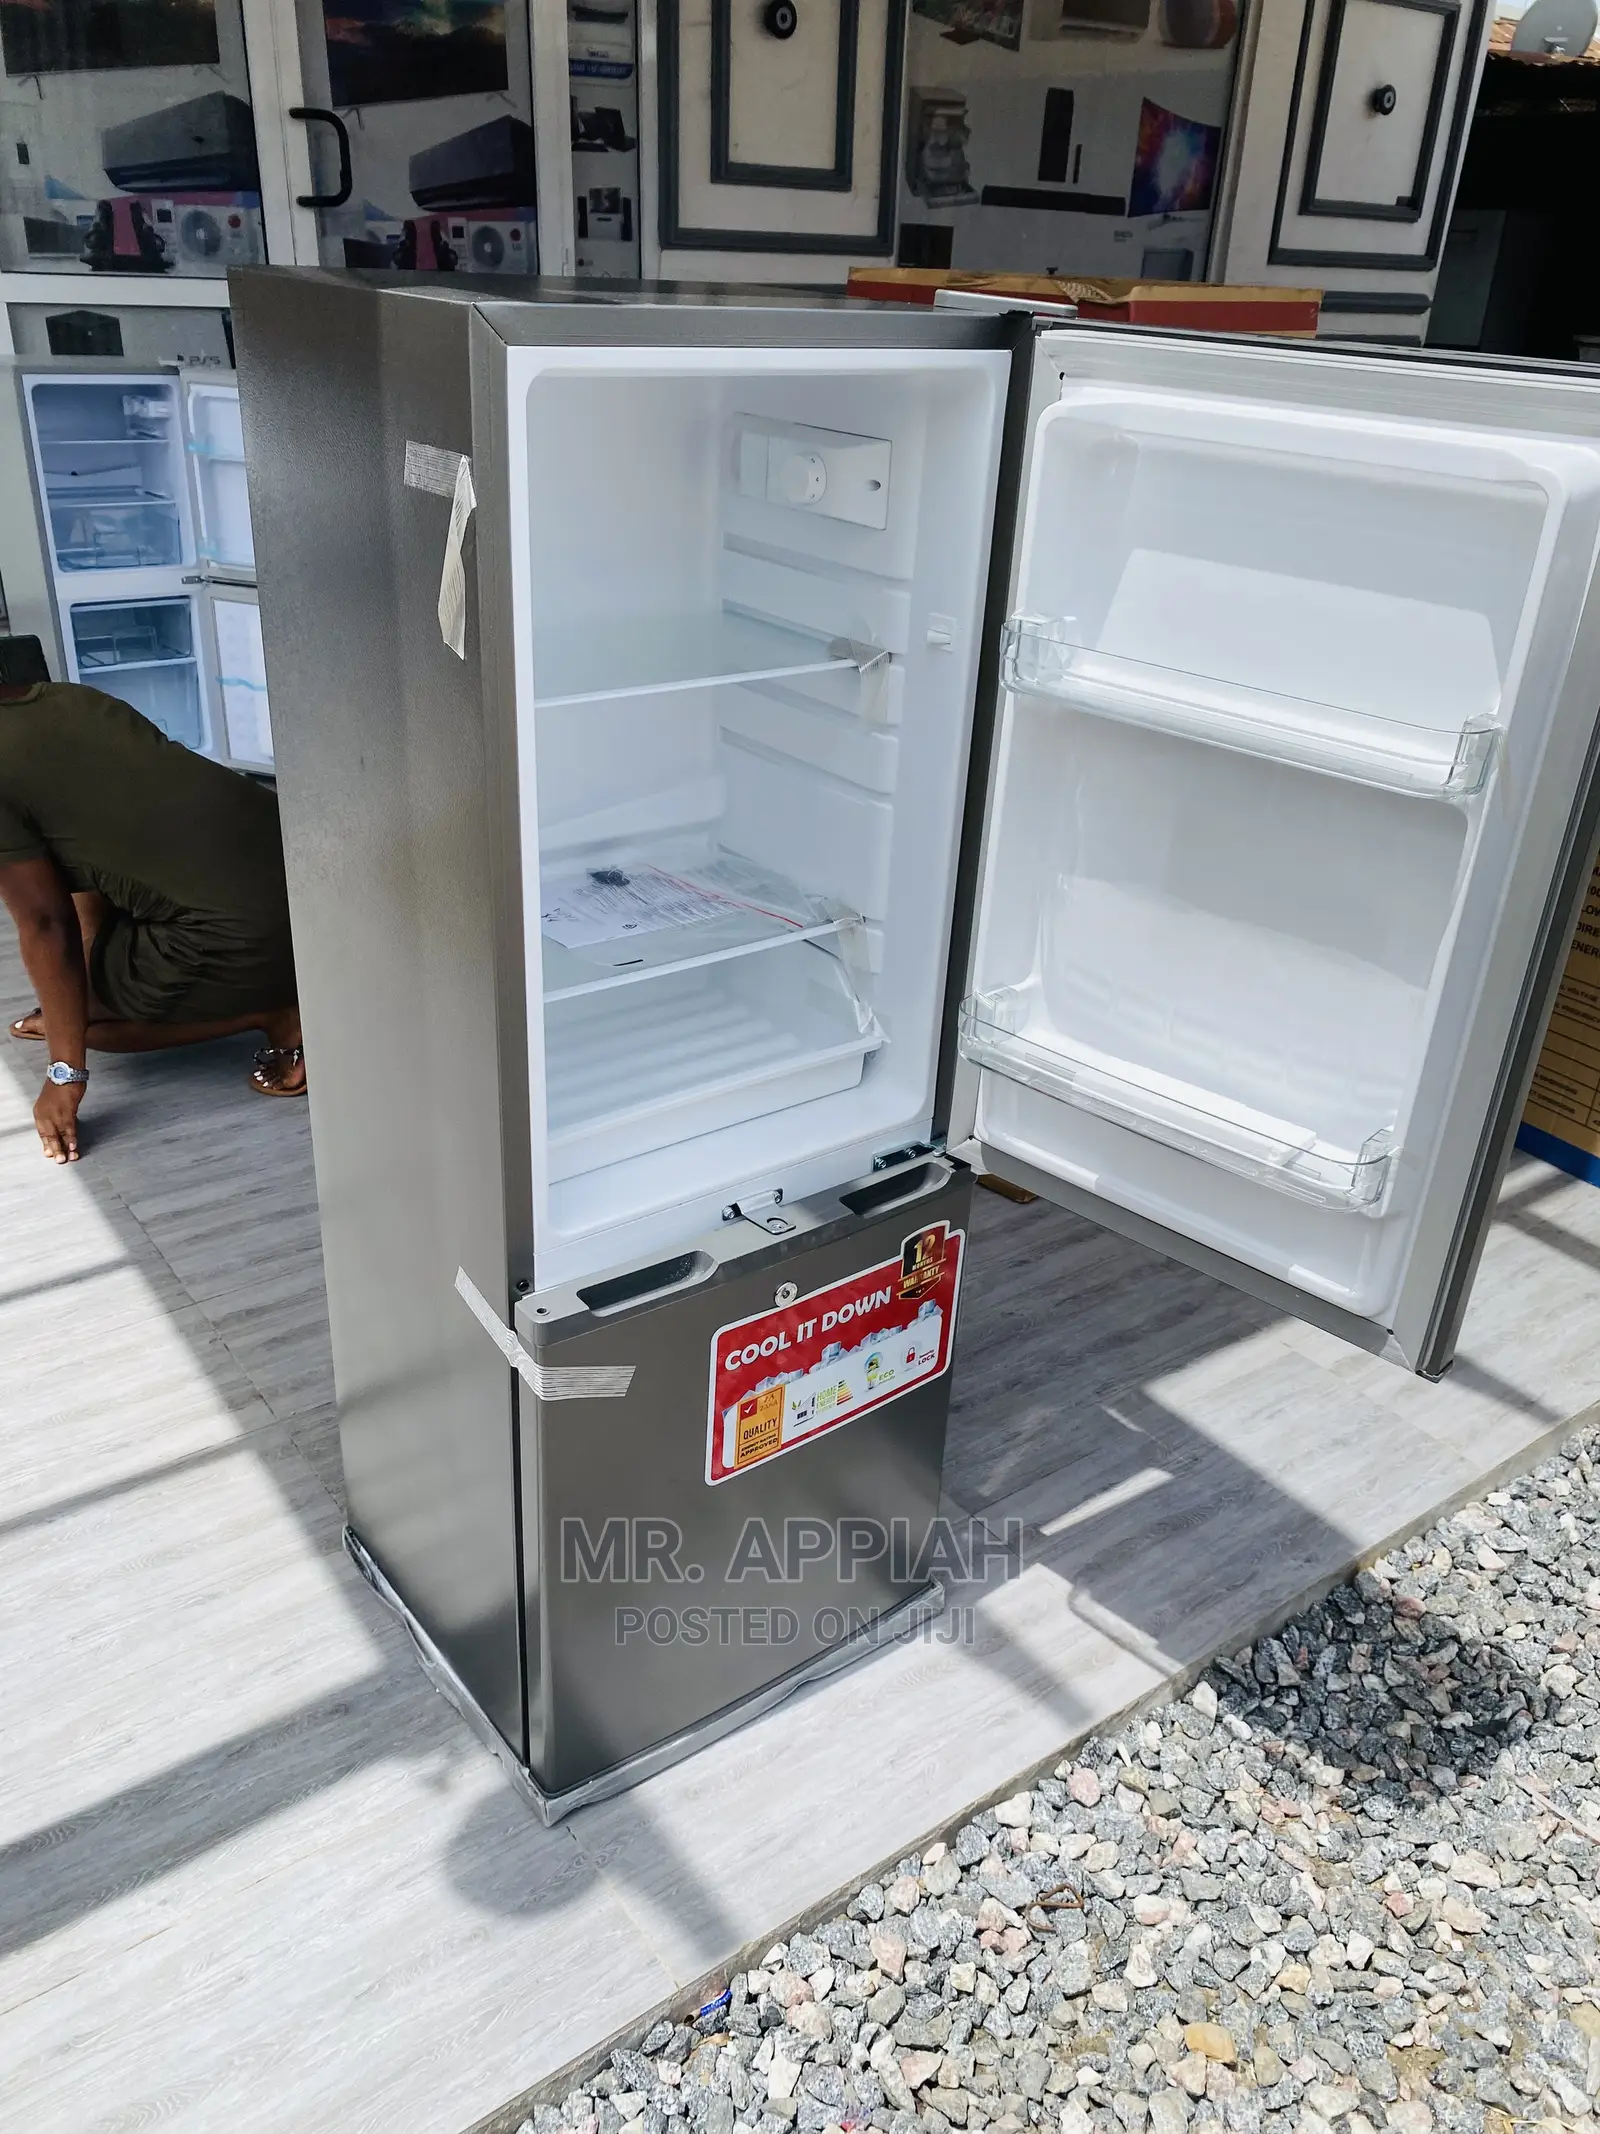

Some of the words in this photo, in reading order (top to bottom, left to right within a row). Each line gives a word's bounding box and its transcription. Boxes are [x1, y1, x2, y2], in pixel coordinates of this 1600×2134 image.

[914, 1234, 936, 1264] 12
[903, 1265, 940, 1289] WARANTY
[724, 1331, 792, 1372] COOL
[796, 1317, 818, 1344] IT
[821, 1285, 892, 1333] DOWN
[918, 1353, 935, 1365] LOCK
[879, 1369, 895, 1381] ECO
[743, 1417, 778, 1440] QUALITY
[740, 1437, 778, 1458] APPROVED
